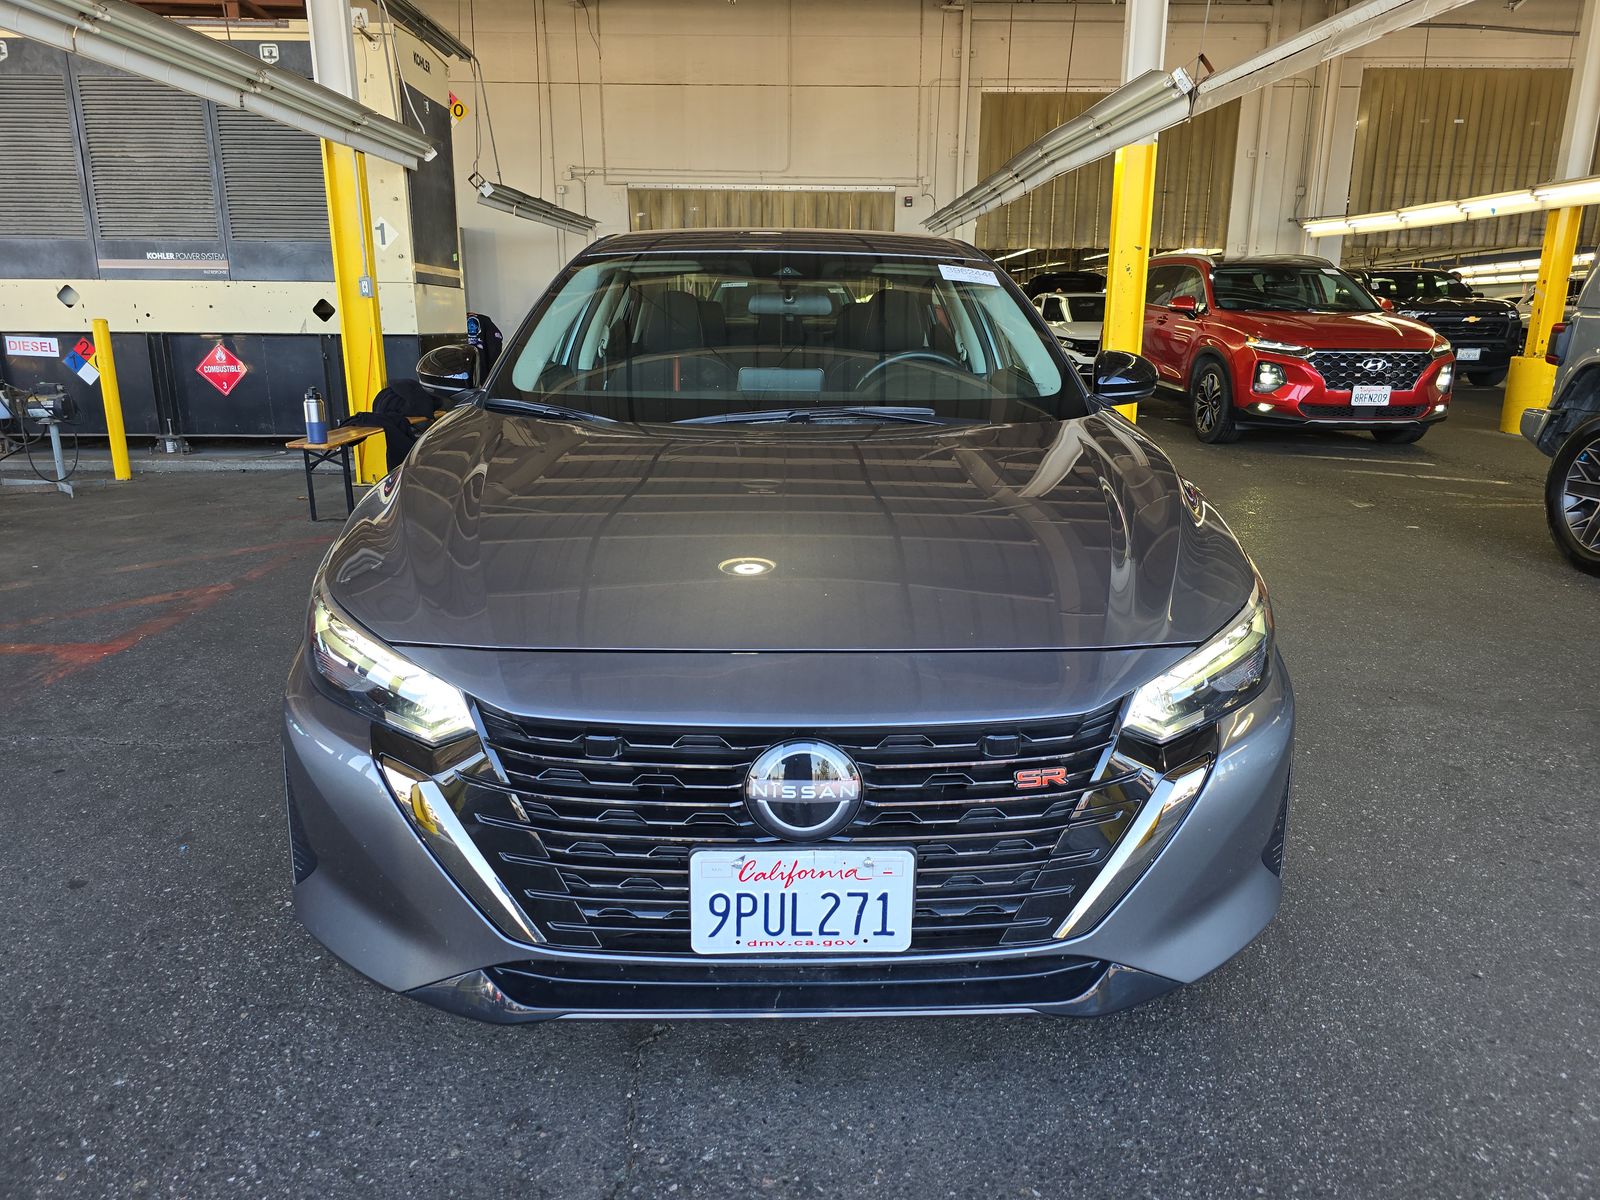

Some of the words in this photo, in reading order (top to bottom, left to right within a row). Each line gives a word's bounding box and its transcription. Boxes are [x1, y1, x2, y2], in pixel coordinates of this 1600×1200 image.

[413, 51, 431, 75] KOHLER
[375, 223, 386, 245] 1
[146, 252, 175, 260] KOHLER
[175, 252, 200, 260] POWER
[8, 340, 57, 353] DIESEL
[79, 341, 91, 356] 2
[70, 354, 78, 369] 1
[203, 365, 241, 373] COMBUSTIBLE
[222, 381, 228, 389] 3
[1354, 393, 1388, 403] 8RFN209
[1014, 767, 1068, 789] SR
[751, 782, 857, 799] NISSAN
[738, 859, 873, 889] California
[708, 892, 895, 938] 9PUL271
[747, 939, 857, 948] dmv.ca.gov
